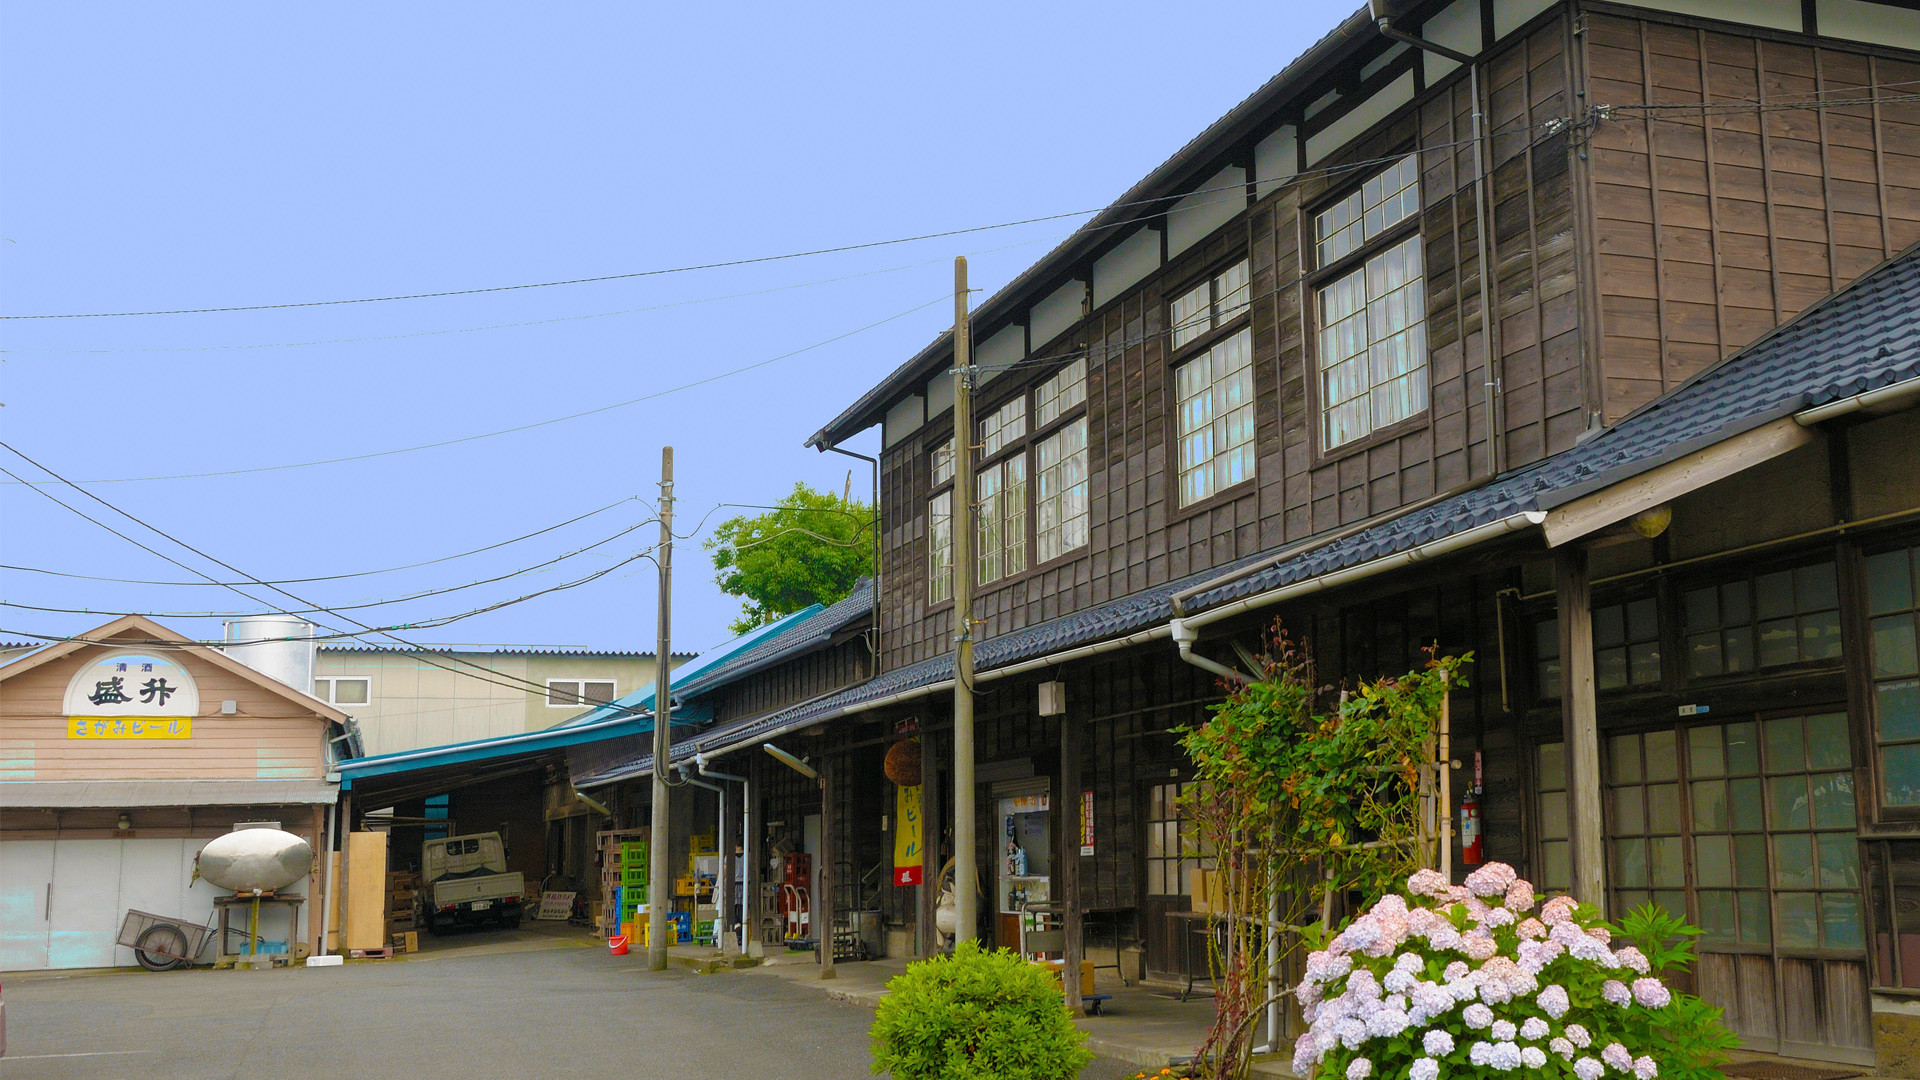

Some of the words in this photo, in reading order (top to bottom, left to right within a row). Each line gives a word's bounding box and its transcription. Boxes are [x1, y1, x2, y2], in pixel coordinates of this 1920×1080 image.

[116, 663, 153, 672] 清酒
[87, 676, 178, 707] 盛升
[76, 720, 185, 736] さがみビール
